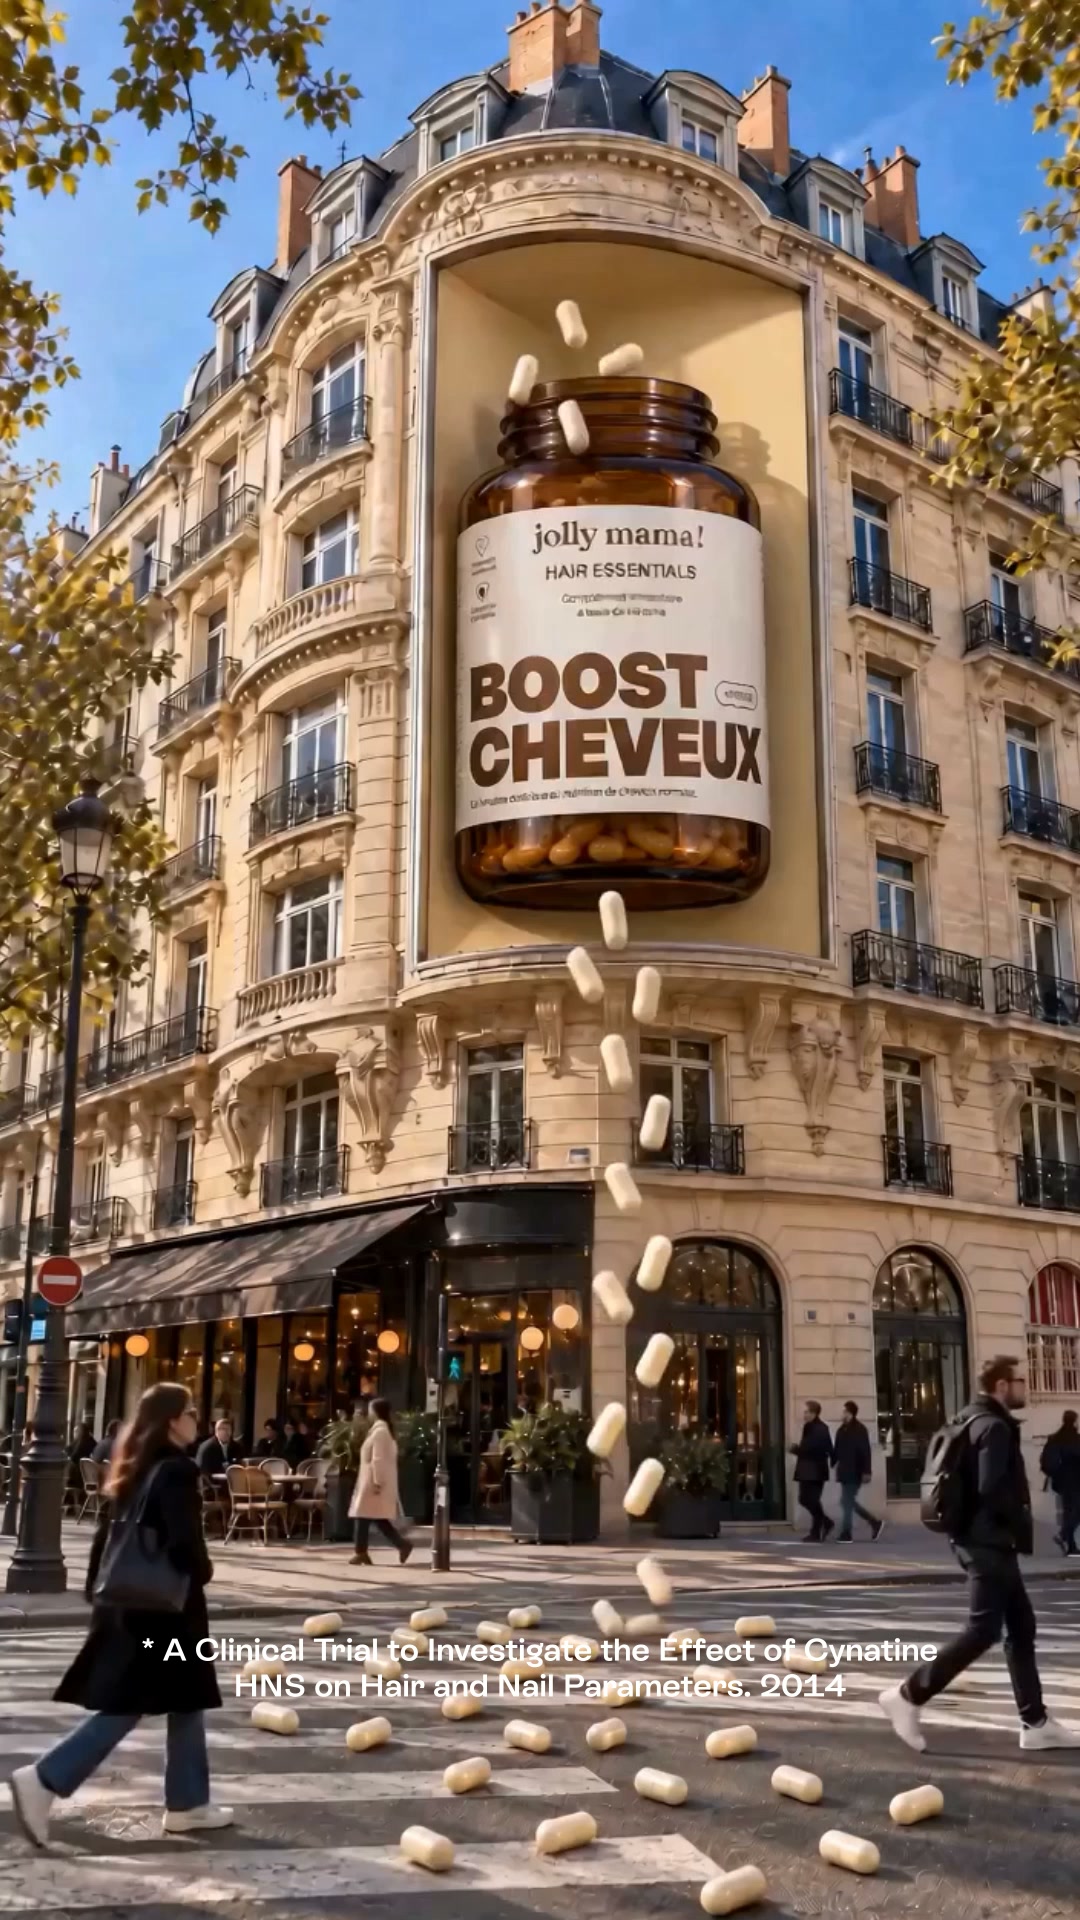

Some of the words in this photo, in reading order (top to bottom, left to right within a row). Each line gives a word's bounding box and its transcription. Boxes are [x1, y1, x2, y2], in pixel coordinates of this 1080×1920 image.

[532, 521, 598, 554] jolly
[605, 525, 704, 548] mama!
[546, 563, 588, 581] HAIR
[593, 562, 696, 580] ESSENTIALS
[470, 652, 707, 722] BOOST
[469, 717, 762, 787] CHEVEUX
